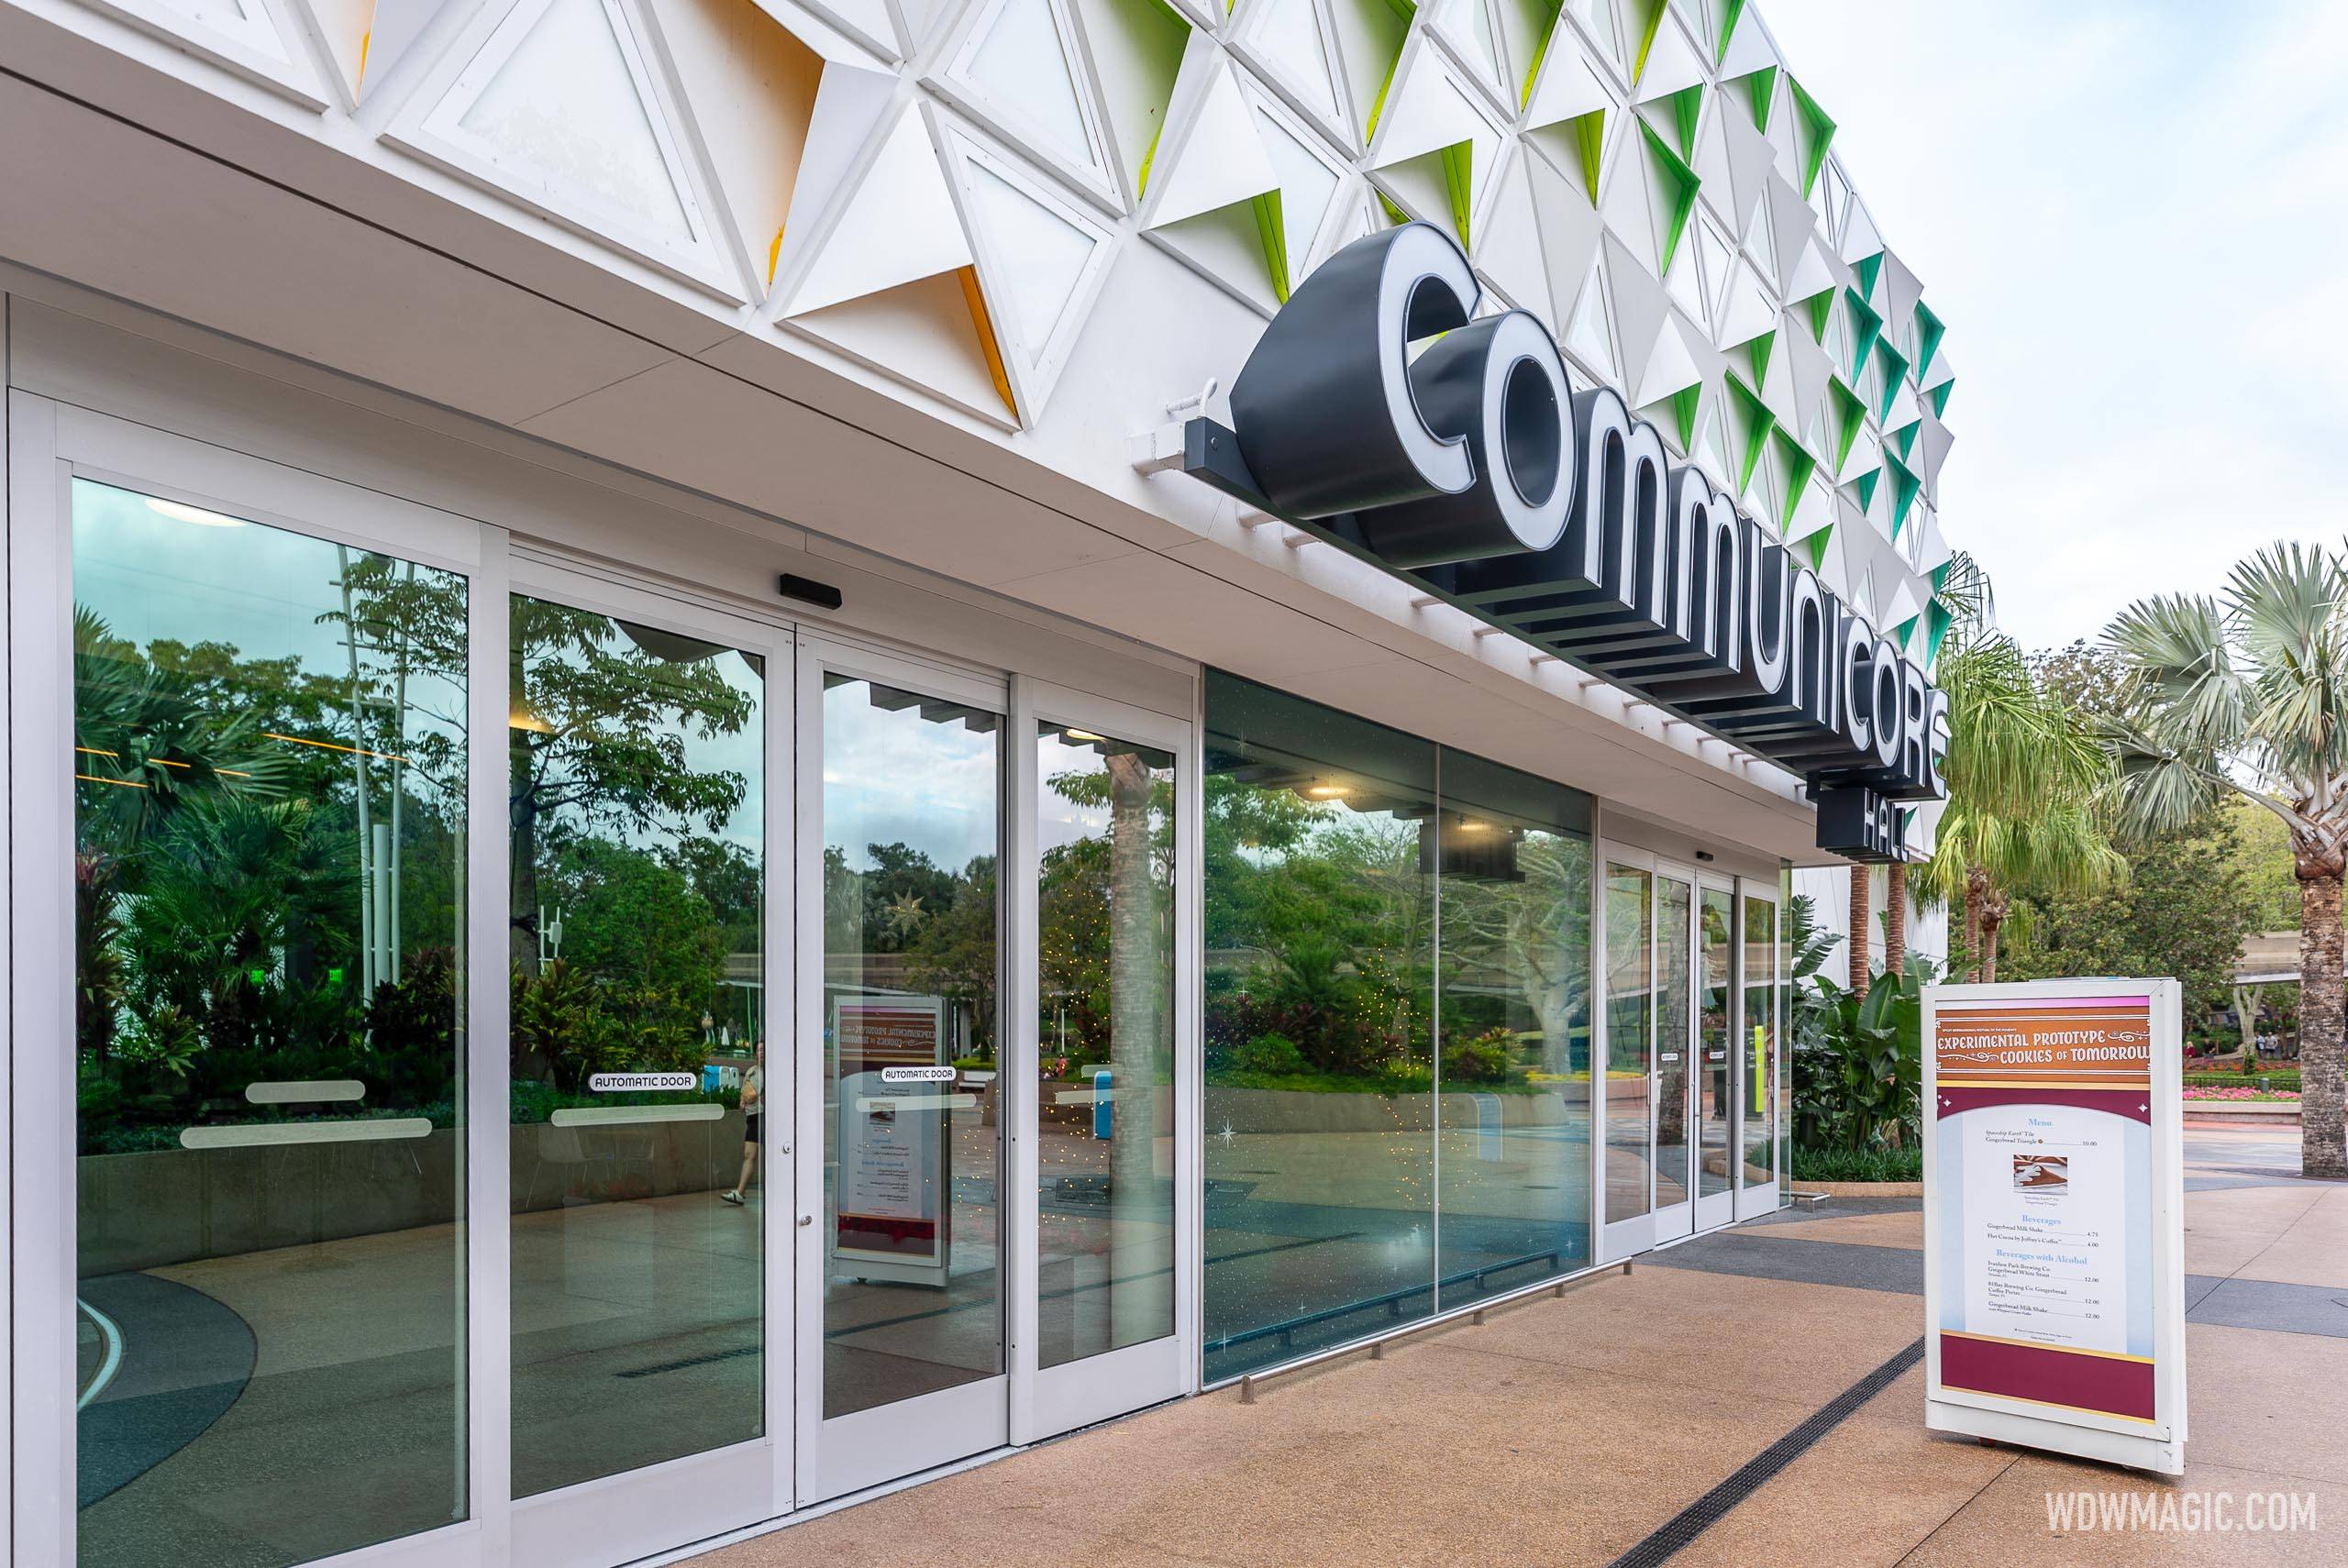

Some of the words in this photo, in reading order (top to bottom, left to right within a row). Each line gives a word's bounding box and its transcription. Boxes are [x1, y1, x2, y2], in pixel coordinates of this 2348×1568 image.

[1861, 787, 1910, 862] HALL
[1938, 1032, 2029, 1050] EXPERIMENTAL
[2033, 1031, 2106, 1046] PROTOTYPE
[1999, 1050, 2052, 1064] COOKIES
[2056, 1051, 2067, 1061] OF
[885, 1070, 930, 1079] AUTOMATIC
[931, 1069, 953, 1078] DOOR
[594, 1077, 659, 1088] AUTOMATIC
[660, 1077, 692, 1087] DOOR
[2028, 1118, 2052, 1127] Menu
[2021, 1214, 2062, 1226] Beverages
[1996, 1249, 2035, 1261] Beverages
[2036, 1253, 2053, 1262] with
[2054, 1254, 2088, 1264] Alcohol
